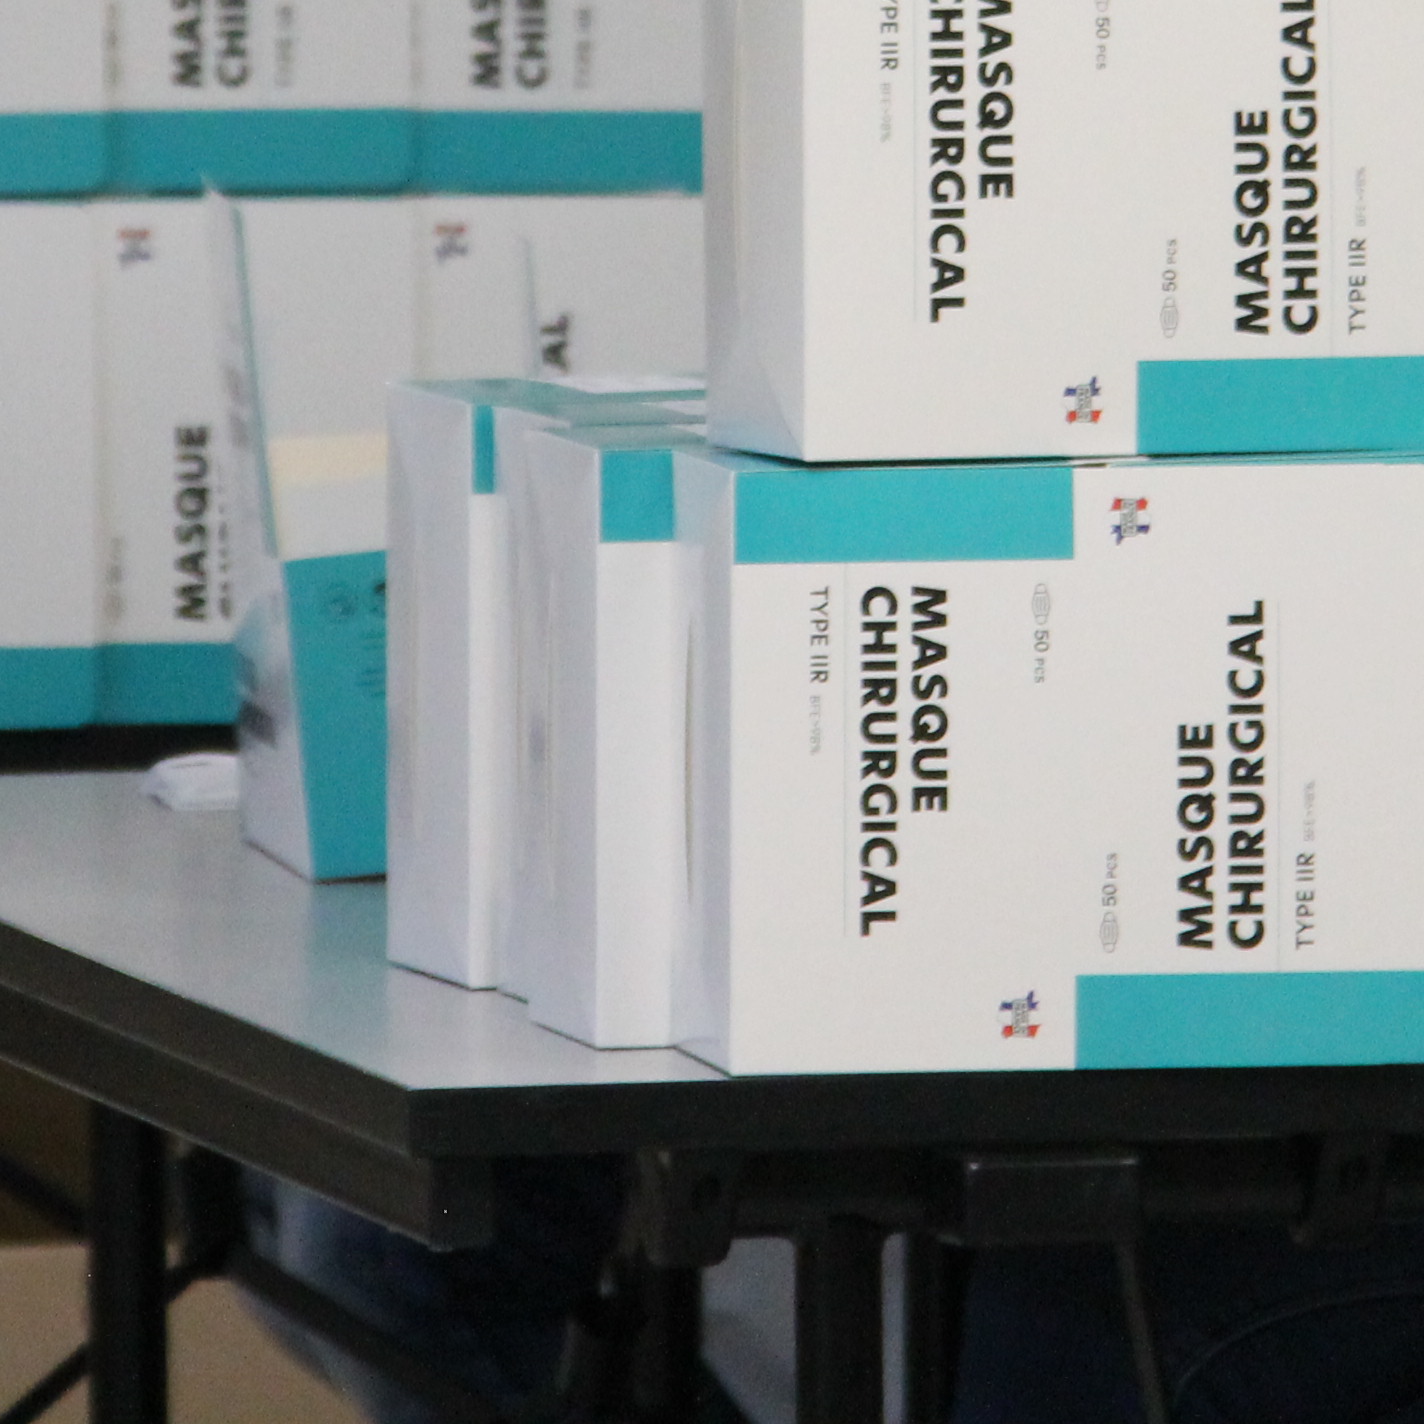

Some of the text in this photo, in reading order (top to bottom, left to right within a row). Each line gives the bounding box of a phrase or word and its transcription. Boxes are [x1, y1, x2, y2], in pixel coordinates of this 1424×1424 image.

[880, 41, 900, 72] IIR
[1094, 15, 1112, 71] 50 PCS
[1234, 111, 1271, 335] MASQUE
[1347, 237, 1367, 268] IIR
[1160, 237, 1179, 293] 50 PCS
[1347, 274, 1368, 335] TYPE
[175, 425, 212, 622] MASQUE
[809, 585, 831, 646] TYPE
[810, 653, 830, 684] IIR
[1032, 628, 1051, 684] 50 PCS
[910, 586, 949, 812] MASQUE
[860, 586, 898, 936] CHIRURGICAL
[1227, 600, 1265, 950] CHIRURGICAL
[1177, 724, 1216, 949] MASQUE
[1100, 851, 1119, 908] 50 PCS
[1295, 852, 1316, 883] IIR
[1294, 889, 1316, 950] TYPE
